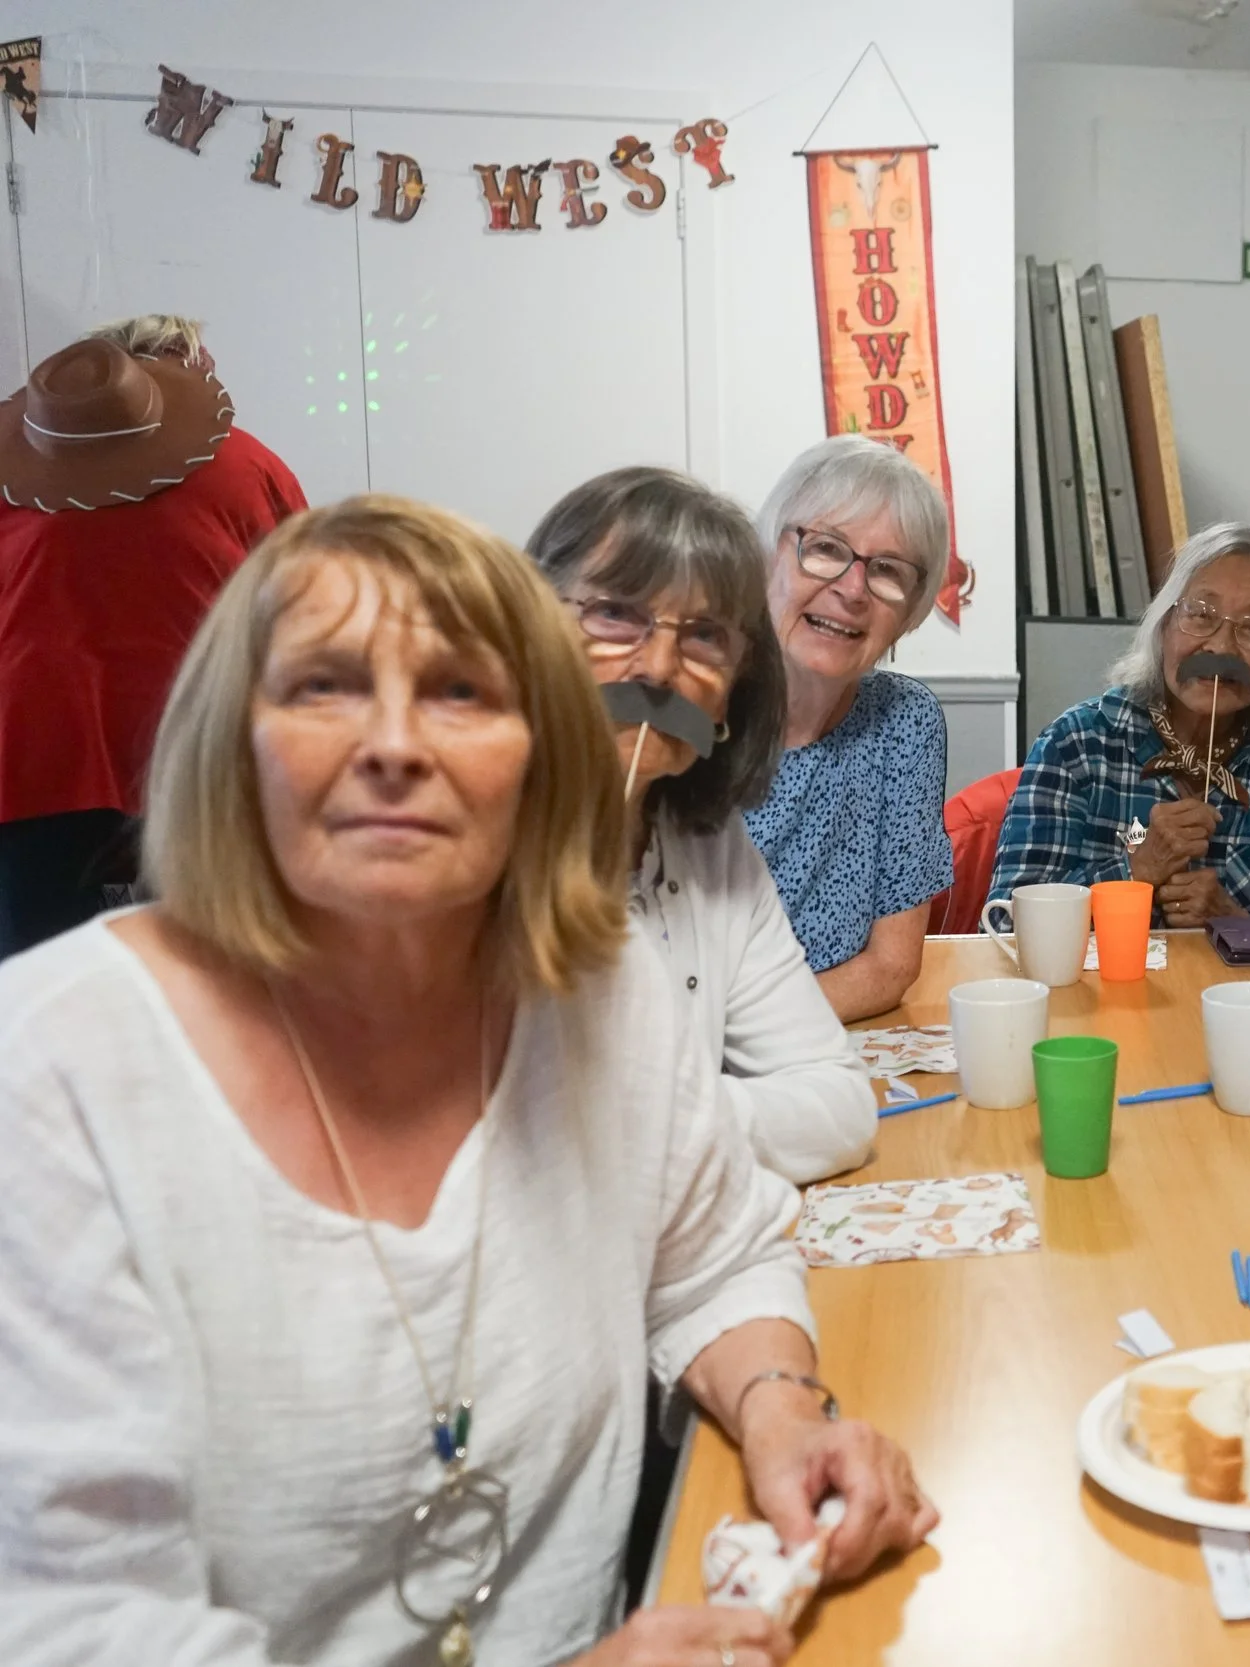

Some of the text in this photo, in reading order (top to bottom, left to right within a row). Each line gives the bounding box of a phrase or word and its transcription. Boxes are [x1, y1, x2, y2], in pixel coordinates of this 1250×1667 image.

[8, 41, 39, 58] WEST
[145, 64, 735, 230] WILD WEST
